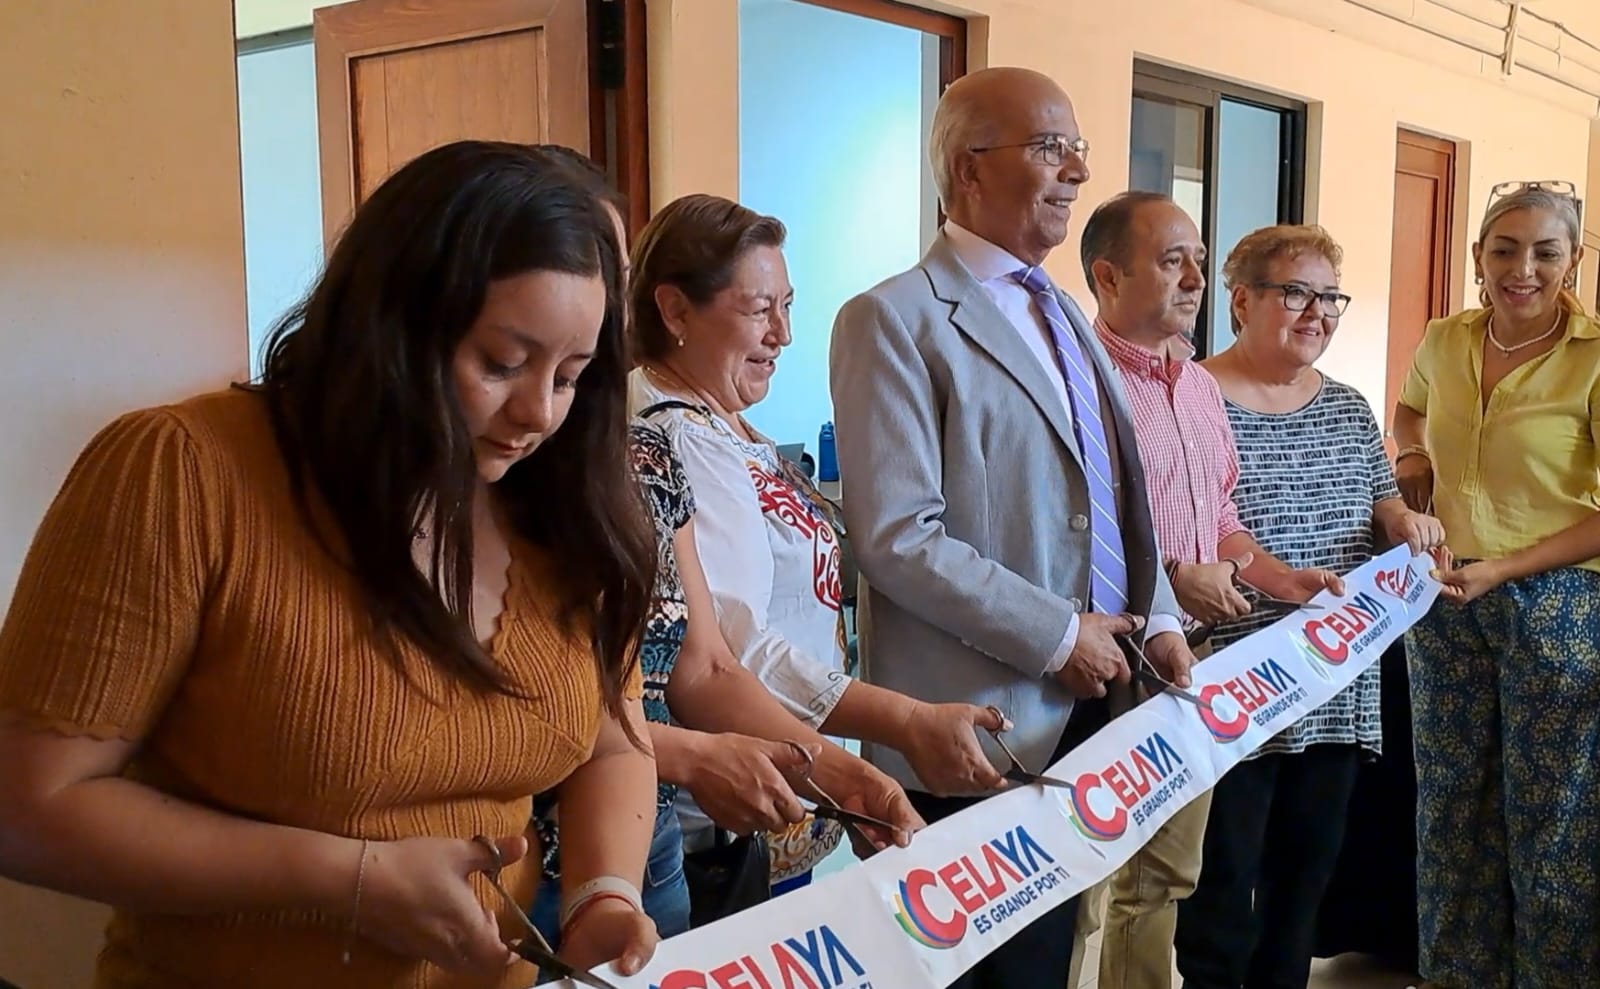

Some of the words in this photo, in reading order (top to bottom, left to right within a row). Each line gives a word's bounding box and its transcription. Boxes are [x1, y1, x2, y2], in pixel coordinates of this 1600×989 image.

[1303, 592, 1387, 665] CELAYA
[1352, 642, 1363, 654] ES
[1198, 658, 1297, 739] CELAYA
[1253, 713, 1266, 726] ES
[1264, 697, 1289, 722] GRANDE
[1071, 732, 1183, 838] CELAYA
[1132, 811, 1145, 826] ES
[1143, 785, 1172, 819] GRANDE
[1170, 773, 1186, 795] POR
[1183, 767, 1193, 784] TI
[900, 825, 1055, 945] CELAYA
[973, 910, 992, 935] ES
[990, 886, 1038, 923] GRANDE
[1036, 872, 1059, 896] POR
[1054, 866, 1070, 884] TI
[657, 925, 865, 989] ELAYA
